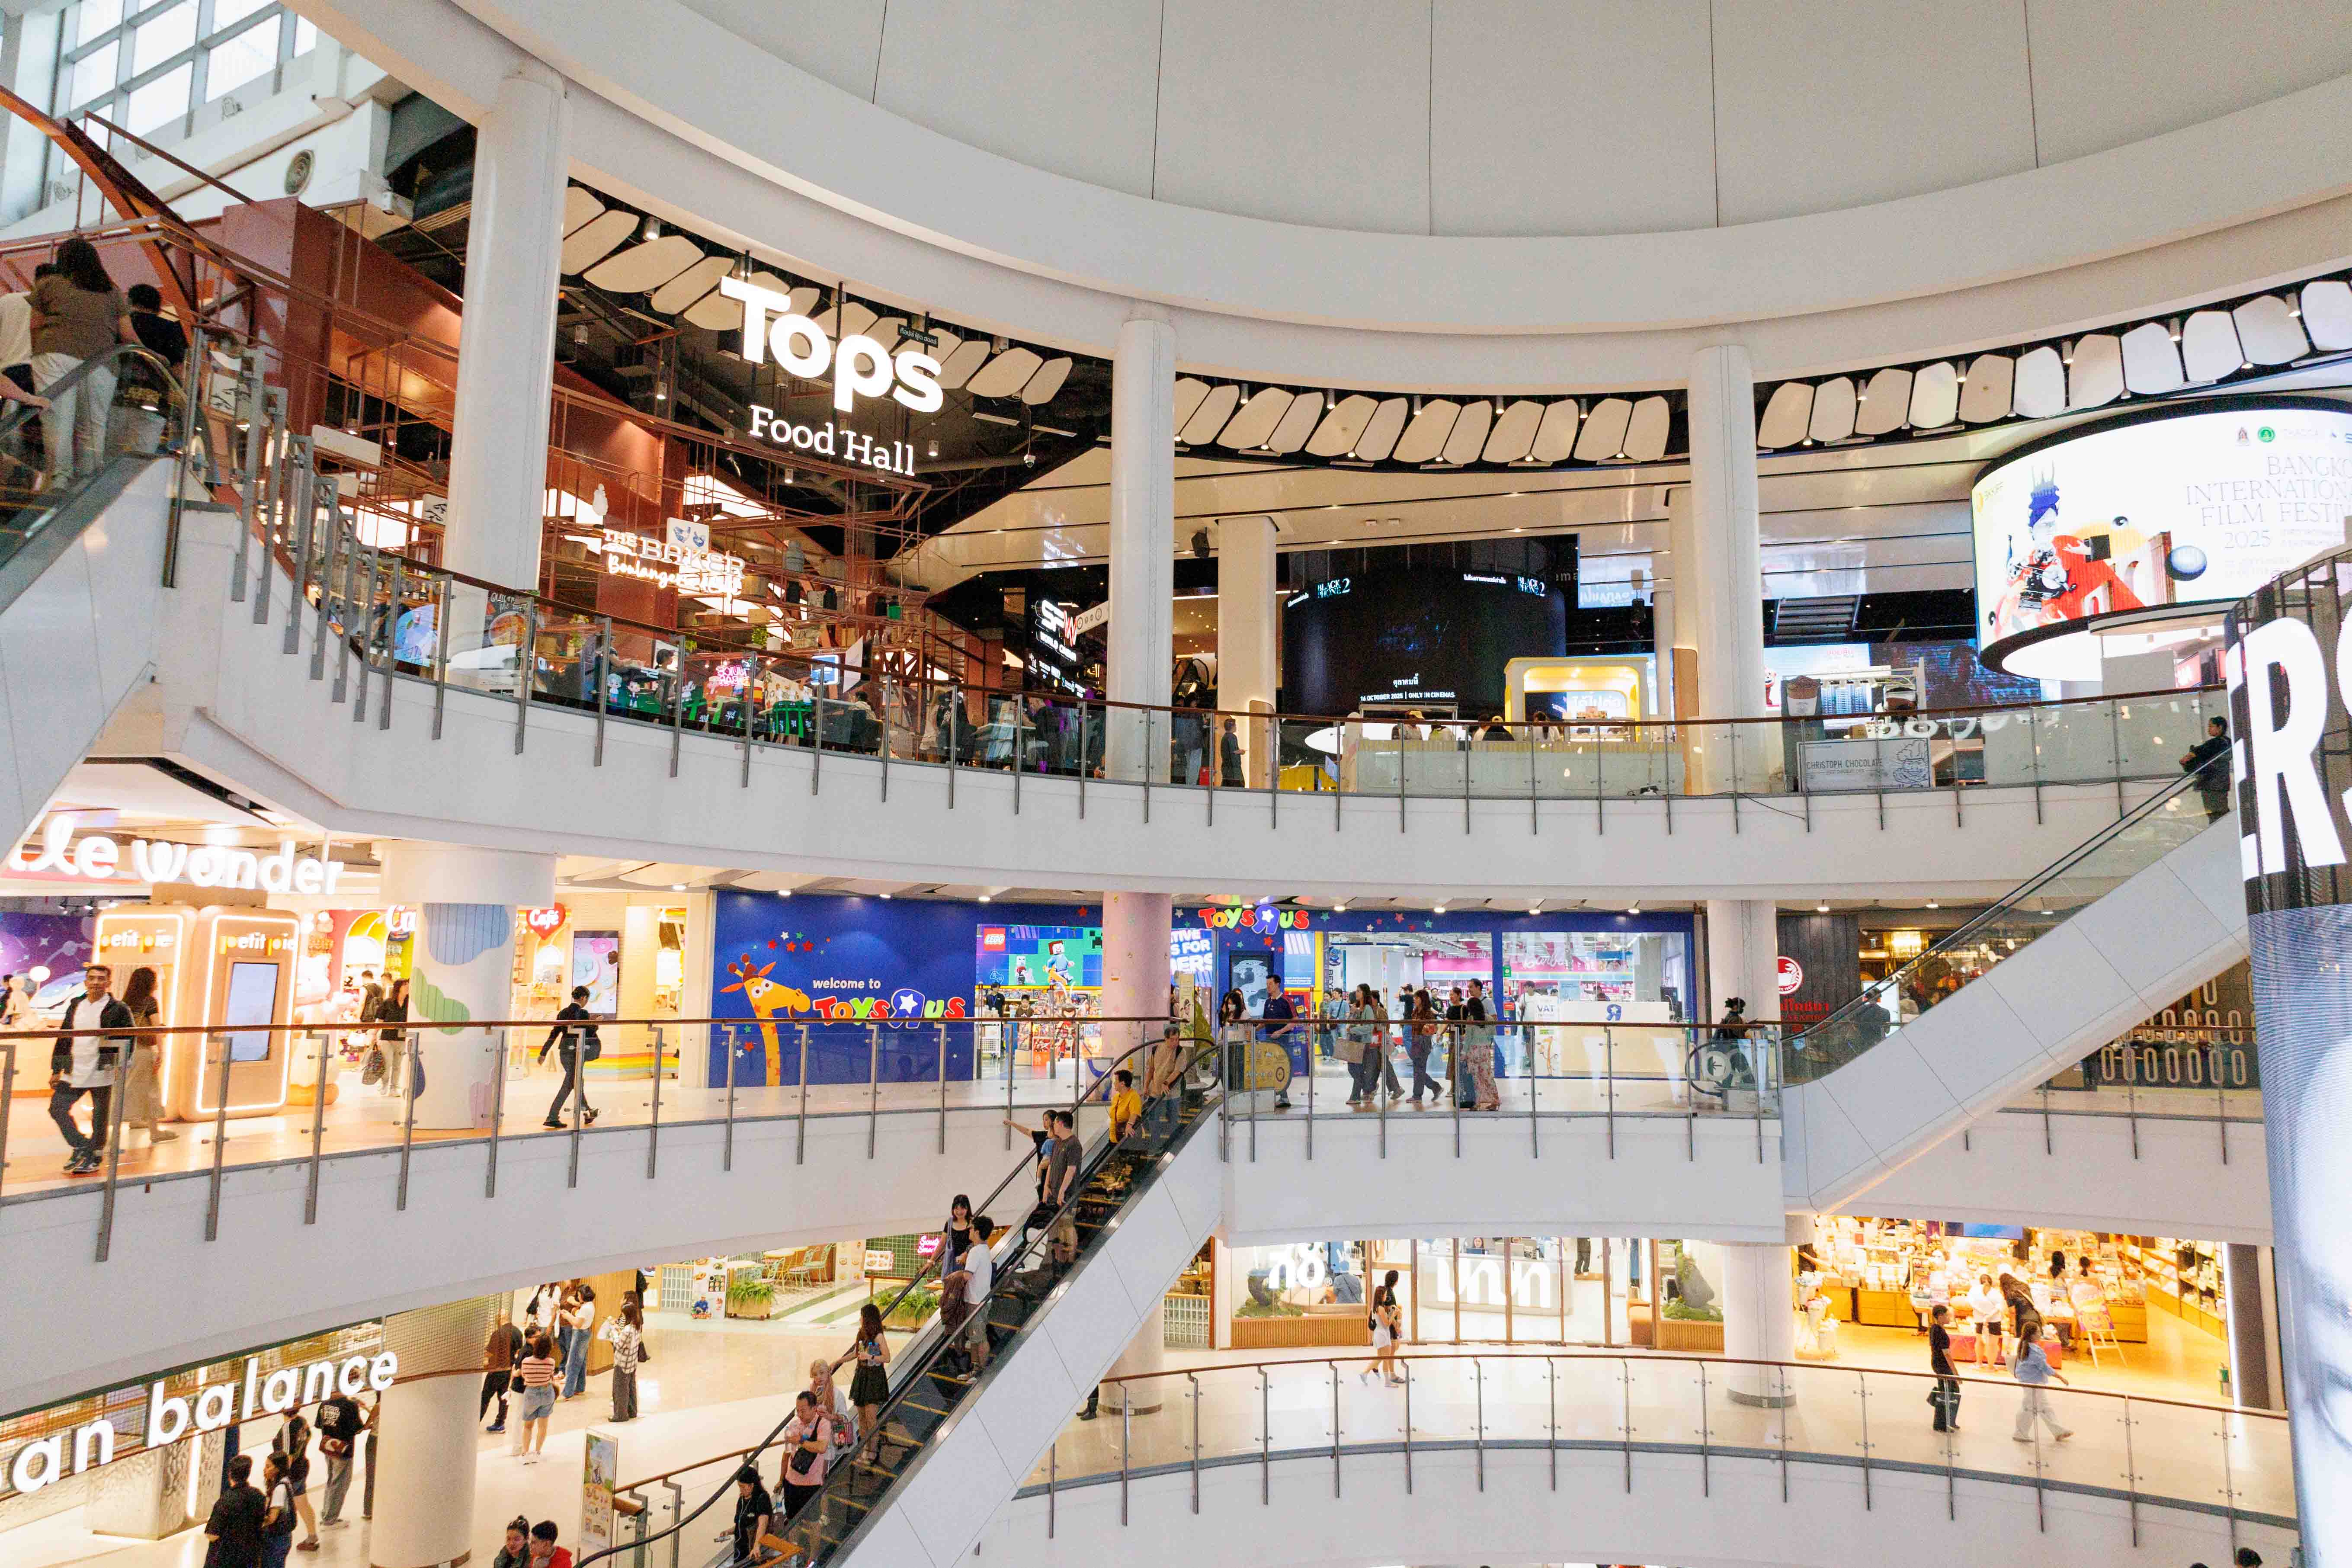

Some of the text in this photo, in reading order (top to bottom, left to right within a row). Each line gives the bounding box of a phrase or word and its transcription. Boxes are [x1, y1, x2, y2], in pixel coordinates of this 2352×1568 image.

[720, 276, 944, 414] Tops
[749, 404, 915, 477] Food Hall
[2186, 479, 2352, 505] INTERNATION
[2201, 503, 2264, 527] FILM
[2224, 530, 2271, 548] 2025
[603, 528, 746, 580] THE BAKER
[1317, 579, 1340, 590] BLACK
[1342, 578, 1350, 593] 2
[1845, 758, 1882, 768] CHOCOLATE
[131, 840, 345, 895] wonder
[529, 909, 560, 929] Café
[99, 929, 174, 953] petit pie
[219, 932, 266, 955] petit
[266, 932, 297, 956] pie
[984, 934, 1005, 945] LEGO
[1182, 939, 1211, 954] FOR
[813, 977, 881, 989] welcome to
[1537, 1004, 1554, 1013] VAT
[0, 1350, 398, 1494] an balance
